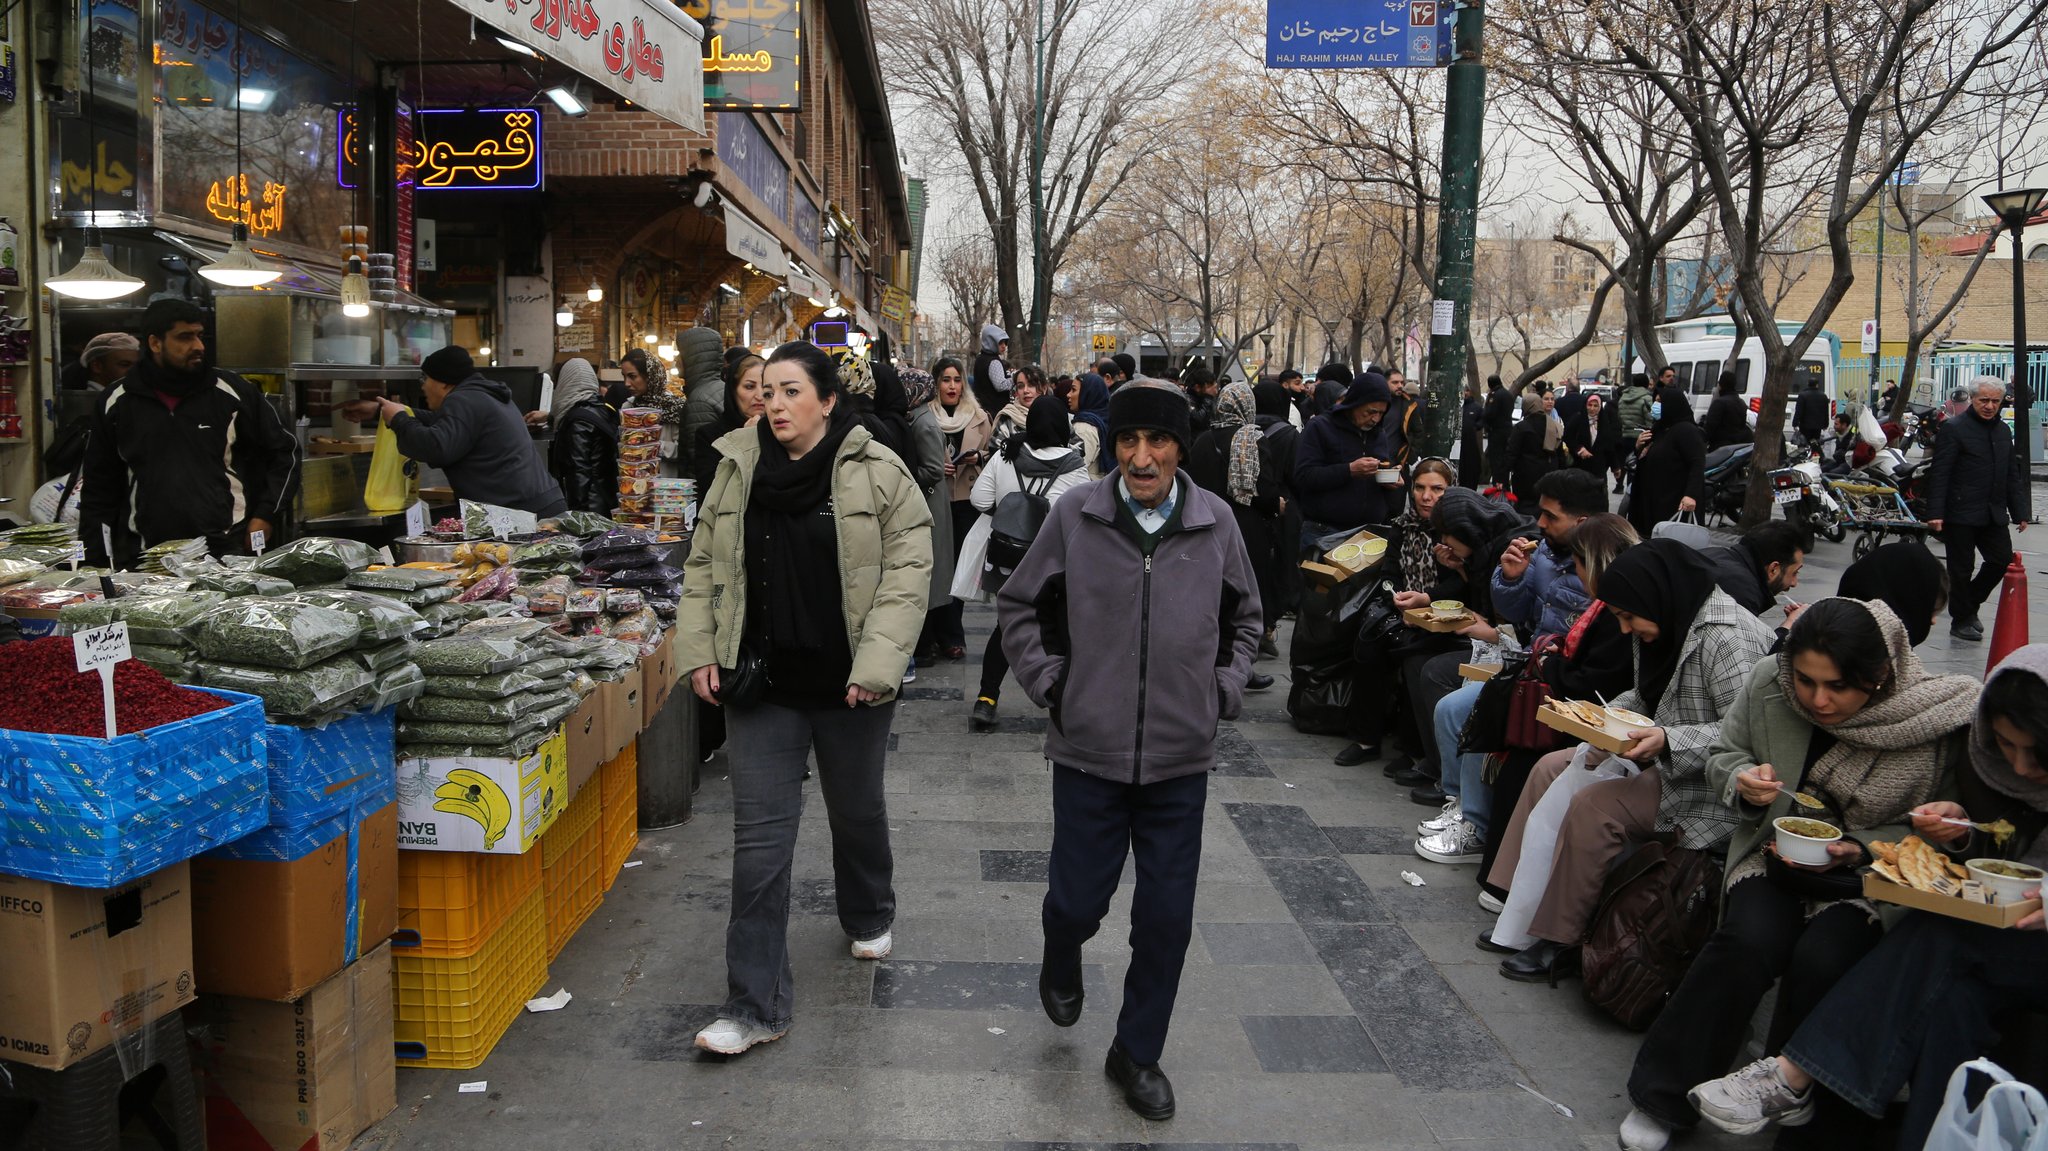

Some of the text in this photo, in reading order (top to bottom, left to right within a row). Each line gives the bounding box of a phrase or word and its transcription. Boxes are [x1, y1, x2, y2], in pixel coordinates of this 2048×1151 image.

[1412, 5, 1433, 24] ۲۶
[1279, 20, 1400, 45] حاج رحیم خان
[602, 17, 664, 83] عطاری
[702, 35, 771, 72] مسل
[1276, 53, 1399, 62] HAJ RAHIM KHAN ALLEY
[61, 140, 134, 205] حلیم
[1809, 365, 1822, 374] 112
[1, 896, 43, 914] IFFCO
[69, 930, 82, 940] NET
[295, 1018, 305, 1047] 32LT
[12, 1038, 50, 1056] ICM25
[297, 1051, 306, 1076] SCO
